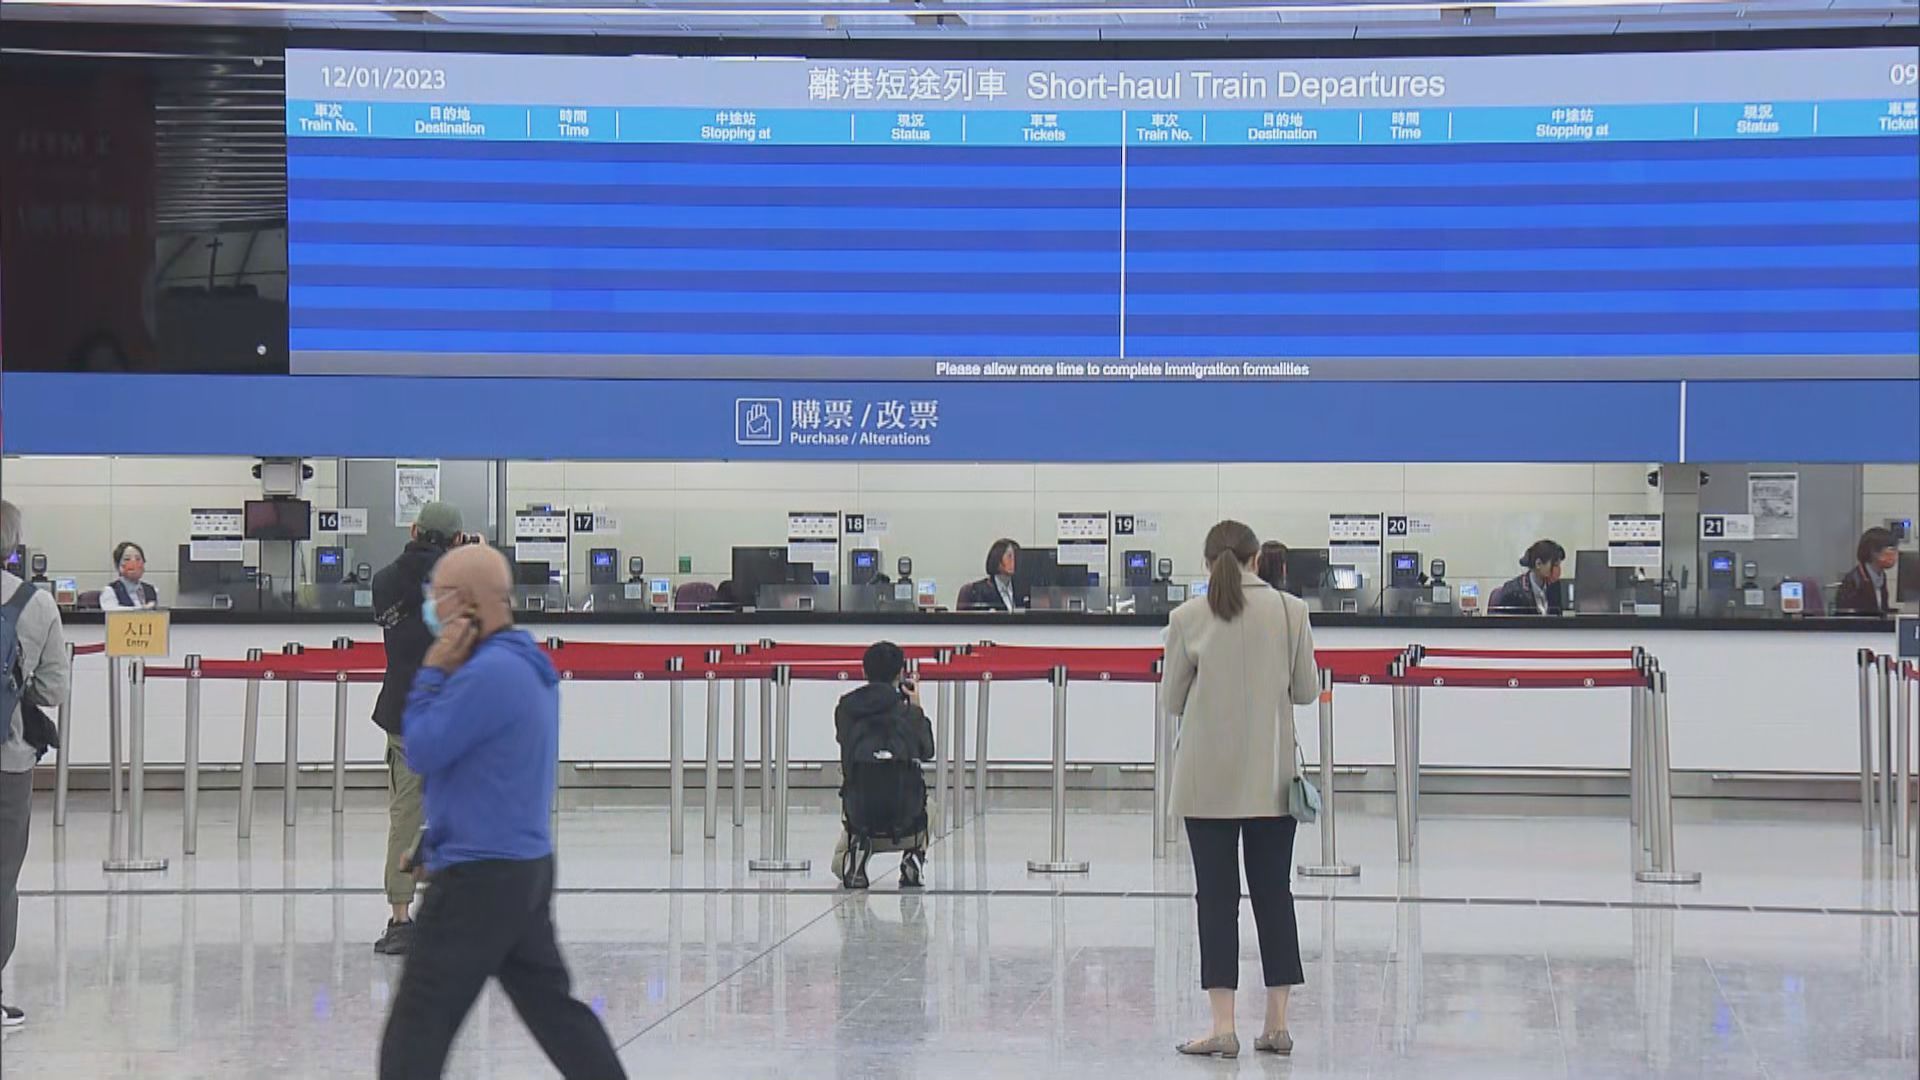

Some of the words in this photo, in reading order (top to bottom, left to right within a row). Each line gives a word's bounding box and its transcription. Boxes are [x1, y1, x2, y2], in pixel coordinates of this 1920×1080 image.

[321, 66, 446, 90] 12/01/2023
[1890, 64, 1918, 85] 09
[807, 67, 1008, 101] 離港短途列車
[1027, 71, 1180, 99] Short-haul
[1191, 71, 1267, 98] Train
[1278, 69, 1446, 104] Departures
[314, 103, 343, 117] 車次
[430, 106, 471, 121] 目的地
[299, 117, 332, 131] Train
[336, 119, 358, 132] No.
[715, 110, 756, 125] 中途站
[1151, 113, 1178, 127] 車次
[1263, 113, 1303, 127] 目的地
[414, 120, 486, 136] Destination
[558, 124, 590, 137] Time
[701, 126, 756, 141] Stopping
[759, 128, 771, 139] at
[1248, 127, 1317, 141] Destination
[1390, 125, 1421, 139] Time
[1536, 123, 1593, 139] Stopping
[1595, 124, 1609, 136] at
[1736, 120, 1780, 134] Status
[891, 128, 931, 141] Status
[1022, 128, 1066, 141] Tickets
[1136, 128, 1168, 141] Train
[1171, 128, 1193, 141] No.
[936, 362, 981, 375] Please
[983, 362, 1017, 375] allow
[1019, 364, 1054, 375] more
[1056, 362, 1084, 375] time
[1087, 362, 1100, 375] to
[1102, 362, 1162, 379] complete
[1164, 362, 1240, 379] immigration
[1242, 362, 1310, 376] formalities
[790, 431, 849, 445] Purchase
[859, 431, 931, 445] Alterations
[320, 514, 337, 526] 16
[576, 516, 591, 529] 17
[847, 518, 862, 530] 18
[1117, 518, 1132, 531] 19
[1389, 519, 1405, 533] 20
[1706, 520, 1722, 533] 21
[124, 621, 153, 637] 入口
[126, 638, 150, 649] Entry
